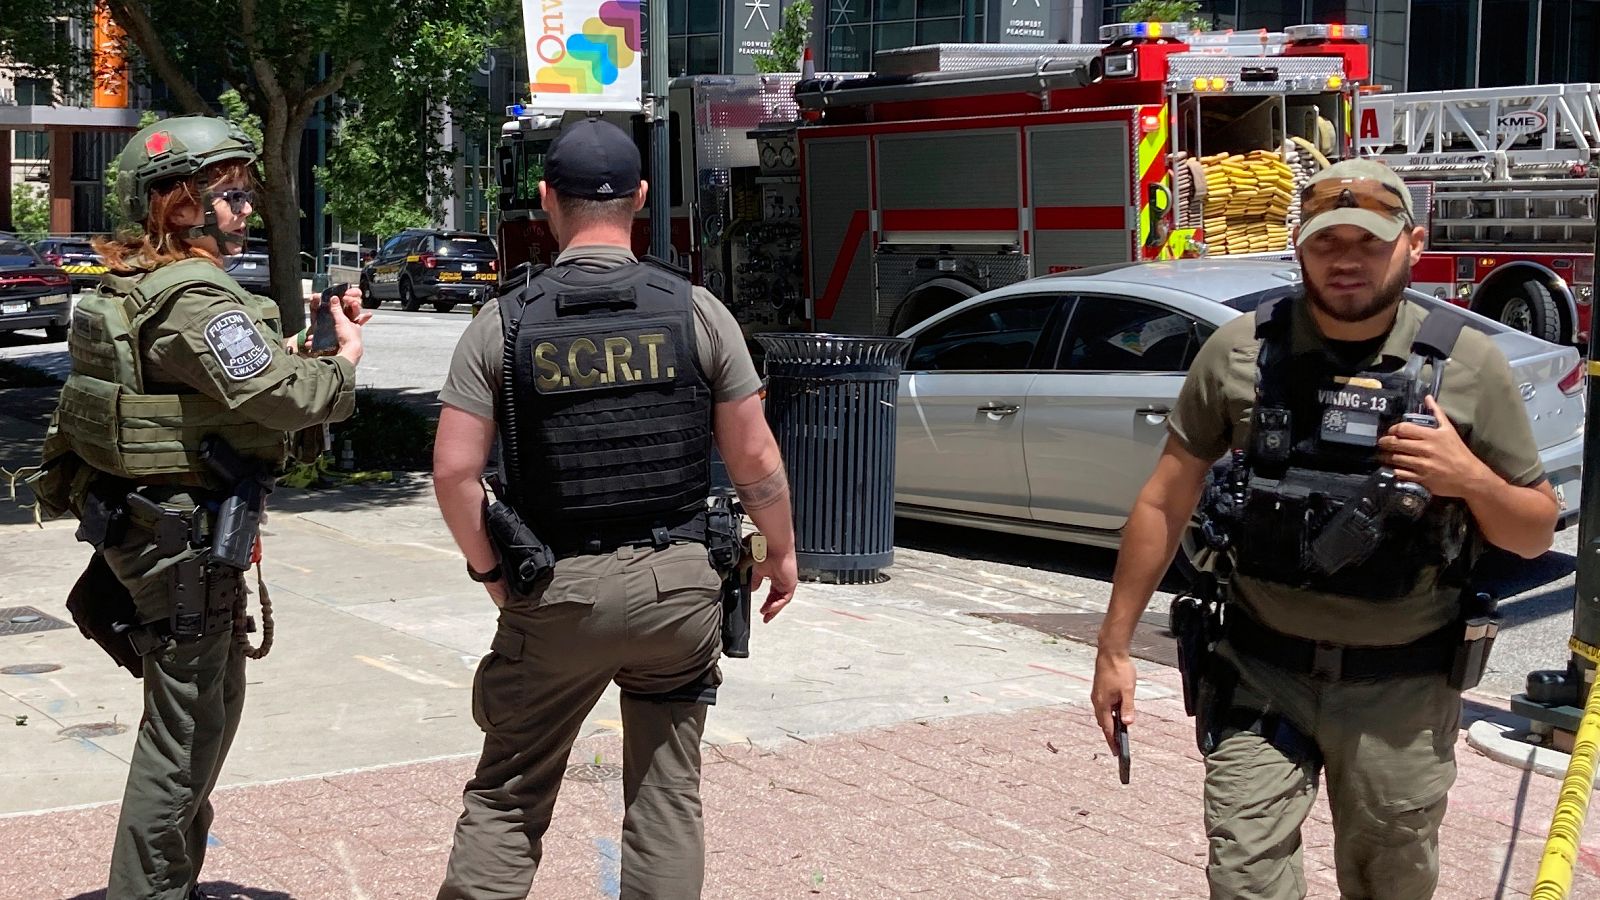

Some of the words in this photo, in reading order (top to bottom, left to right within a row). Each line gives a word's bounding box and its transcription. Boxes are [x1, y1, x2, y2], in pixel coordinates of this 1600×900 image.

[1497, 116, 1536, 127] KME
[209, 315, 244, 337] FULTON
[230, 345, 261, 366] POLICE
[255, 352, 269, 368] TEAM
[535, 334, 675, 389] S.C.R.T.
